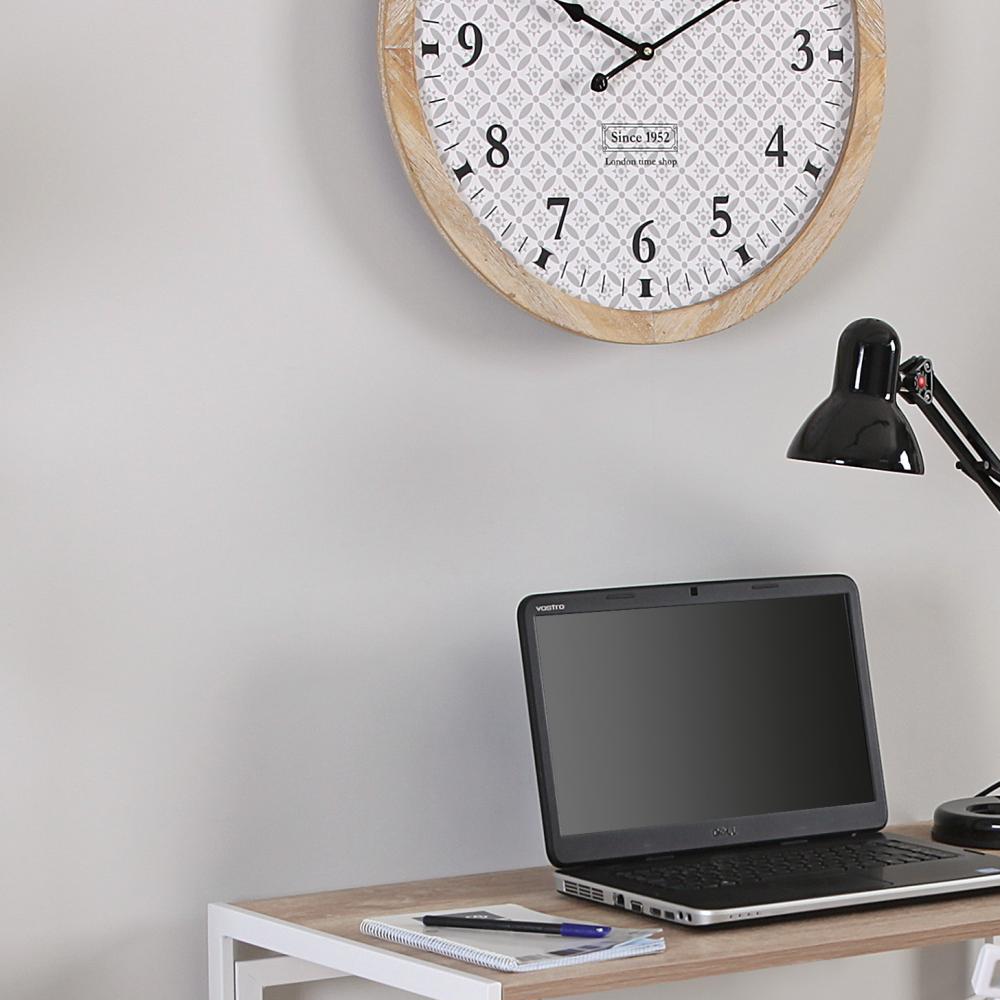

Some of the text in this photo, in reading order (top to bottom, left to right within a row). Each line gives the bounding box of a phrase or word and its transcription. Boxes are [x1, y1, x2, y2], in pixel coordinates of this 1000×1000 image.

[457, 23, 483, 68] 9
[790, 29, 814, 72] 3
[485, 124, 510, 168] 8
[611, 131, 670, 143] Since 1952
[764, 125, 789, 168] 4
[605, 157, 678, 168] London time shop
[546, 197, 570, 240] 7
[709, 195, 732, 238] 5
[632, 220, 656, 264] 6
